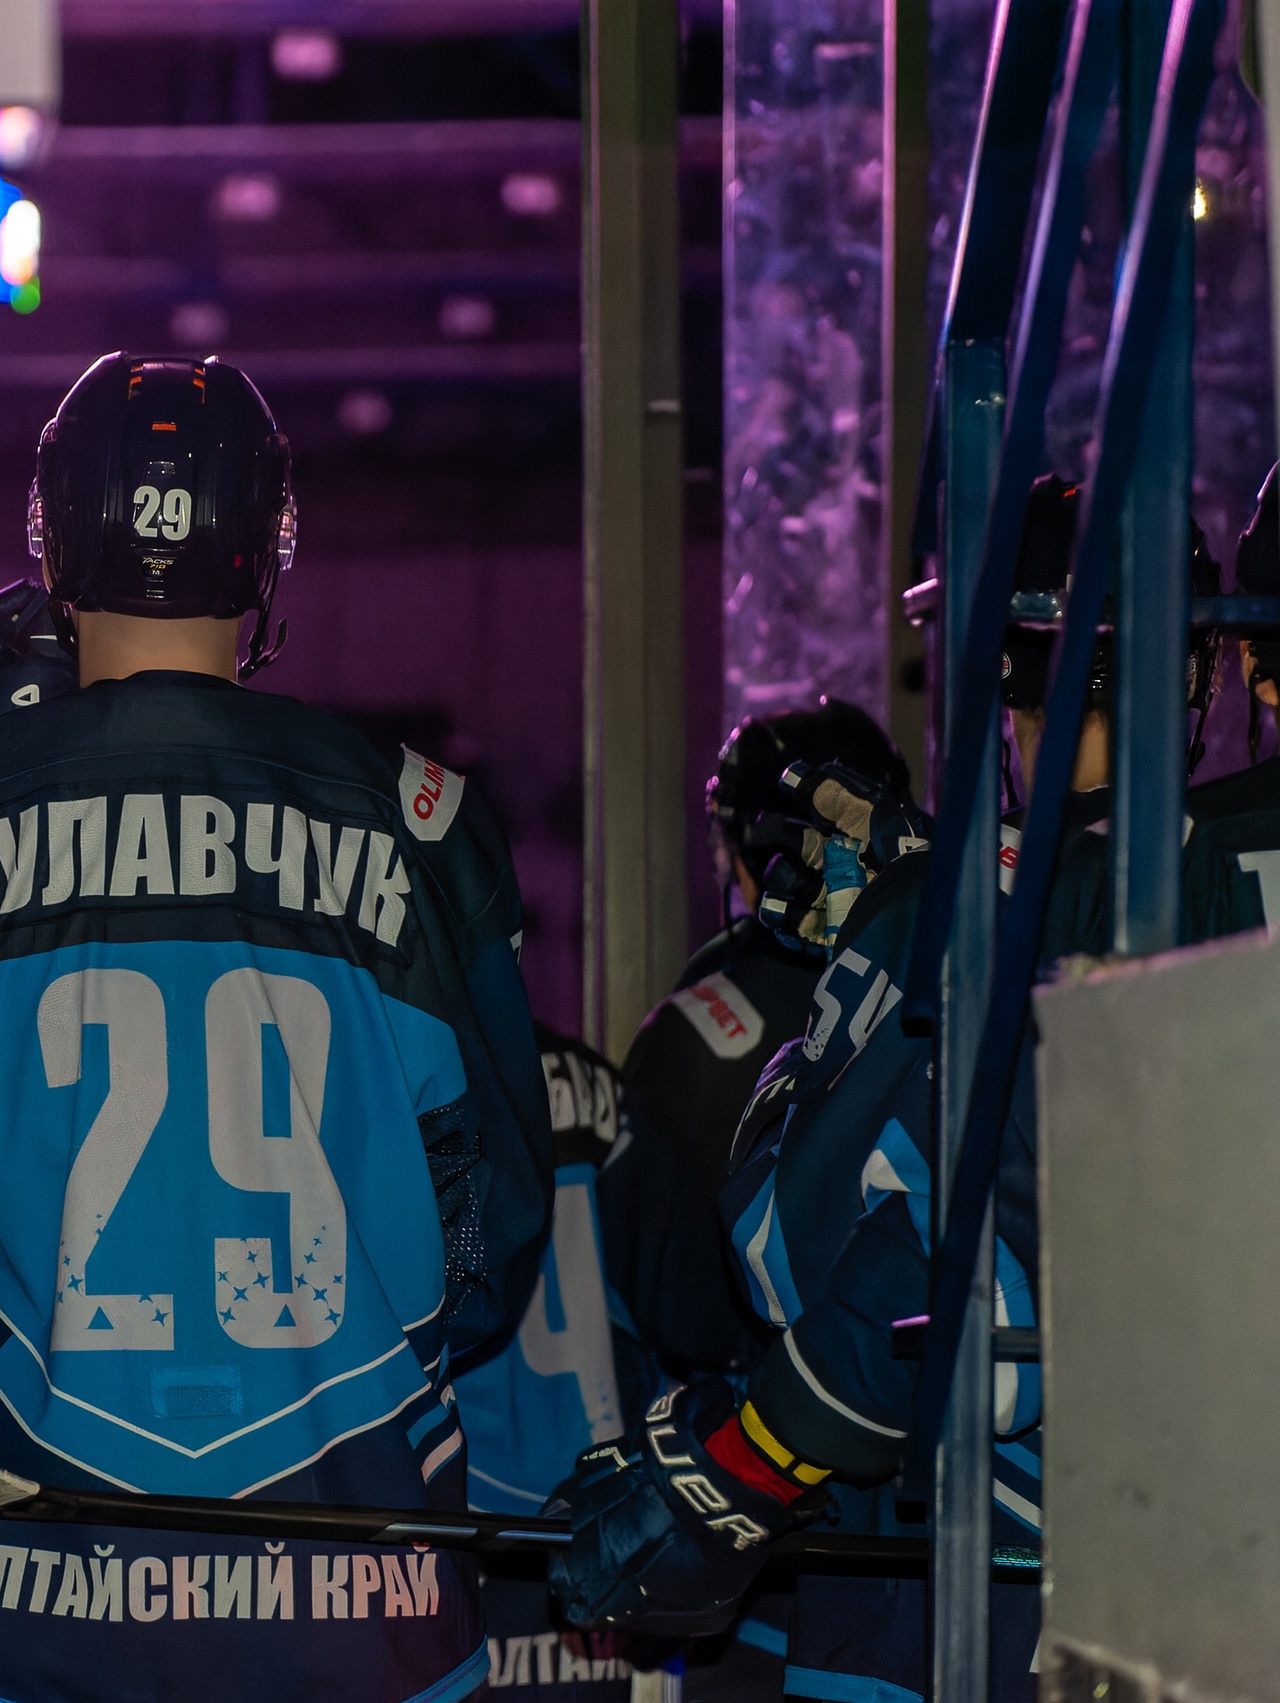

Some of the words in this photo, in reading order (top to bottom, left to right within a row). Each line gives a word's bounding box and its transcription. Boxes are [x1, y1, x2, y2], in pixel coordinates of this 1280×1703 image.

[132, 485, 192, 541] 29
[36, 967, 348, 1351] 29
[312, 1541, 438, 1619] КРАЙ
